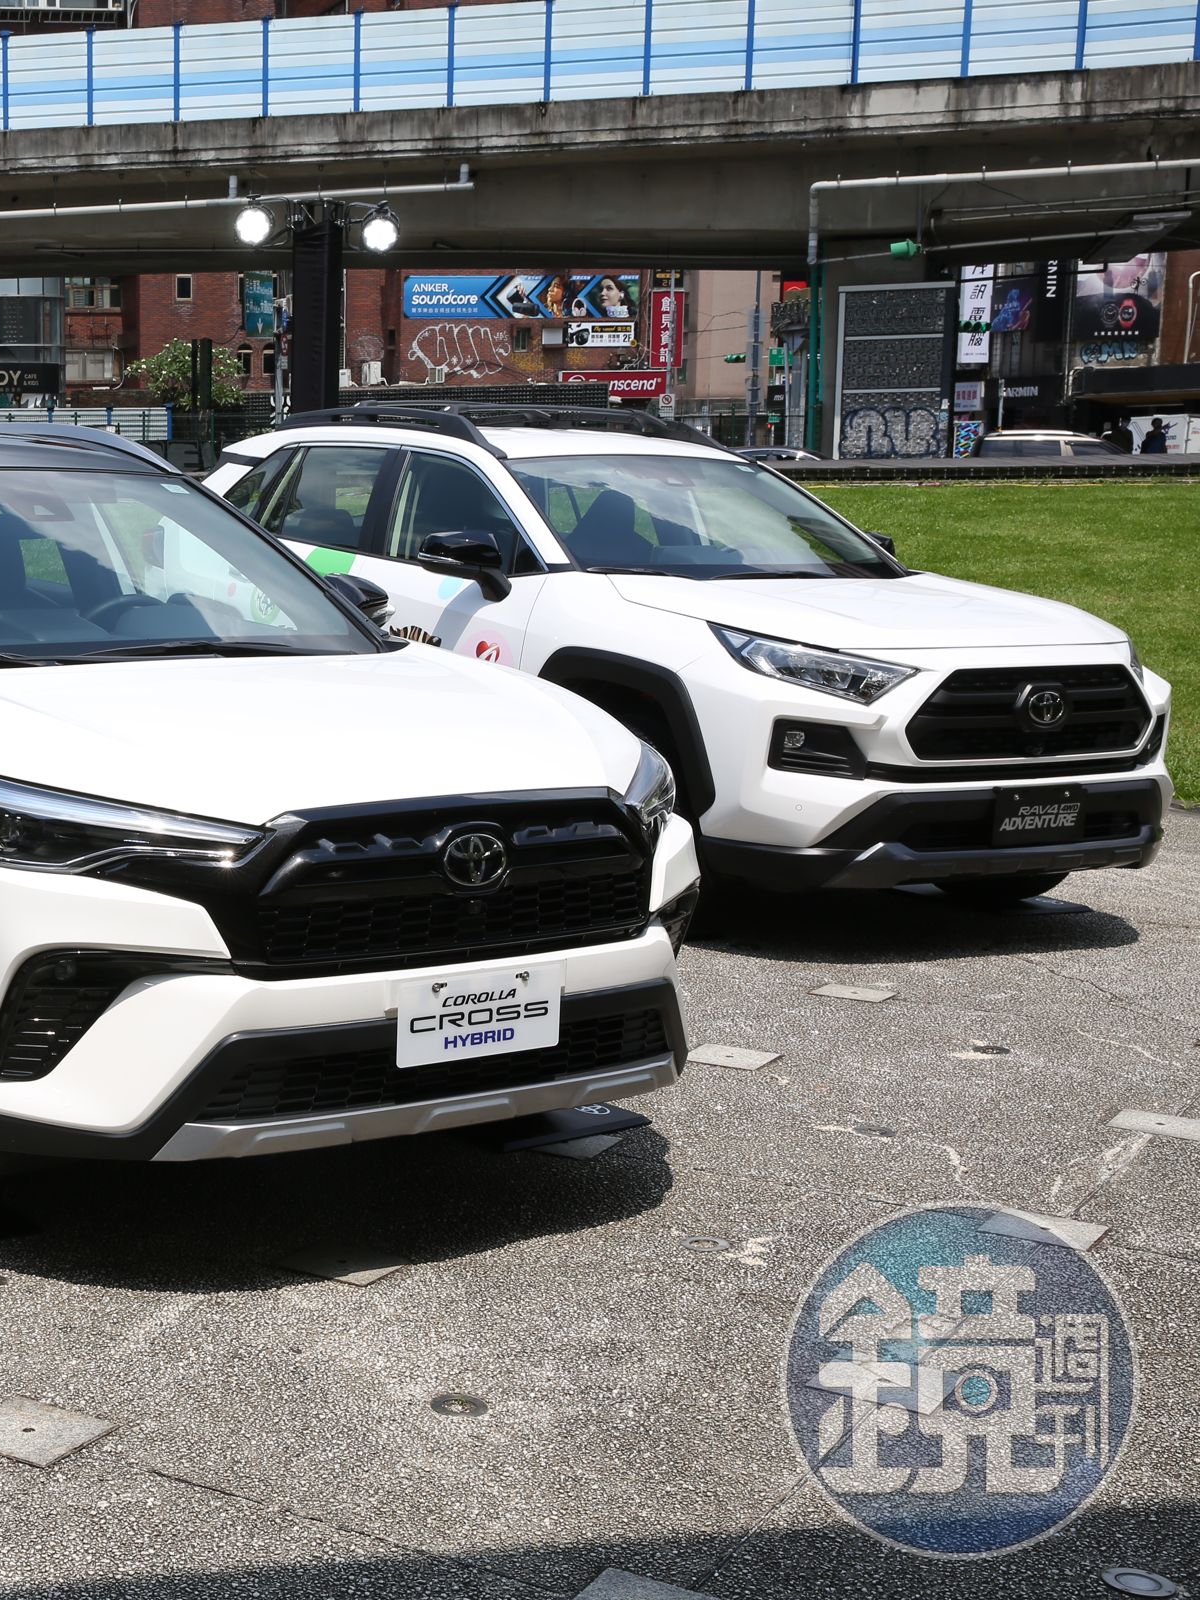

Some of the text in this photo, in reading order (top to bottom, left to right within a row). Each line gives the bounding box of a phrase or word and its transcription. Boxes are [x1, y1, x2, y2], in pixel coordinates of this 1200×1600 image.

[412, 283, 449, 293] ANKER
[411, 289, 479, 305] soundcore
[608, 378, 657, 391] nscend
[1018, 804, 1059, 816] RAV4
[1000, 813, 1077, 831] ADVENTURE
[442, 988, 517, 1008] COROLLA
[409, 1000, 549, 1034] CROSS
[444, 1027, 515, 1050] HYBRID
